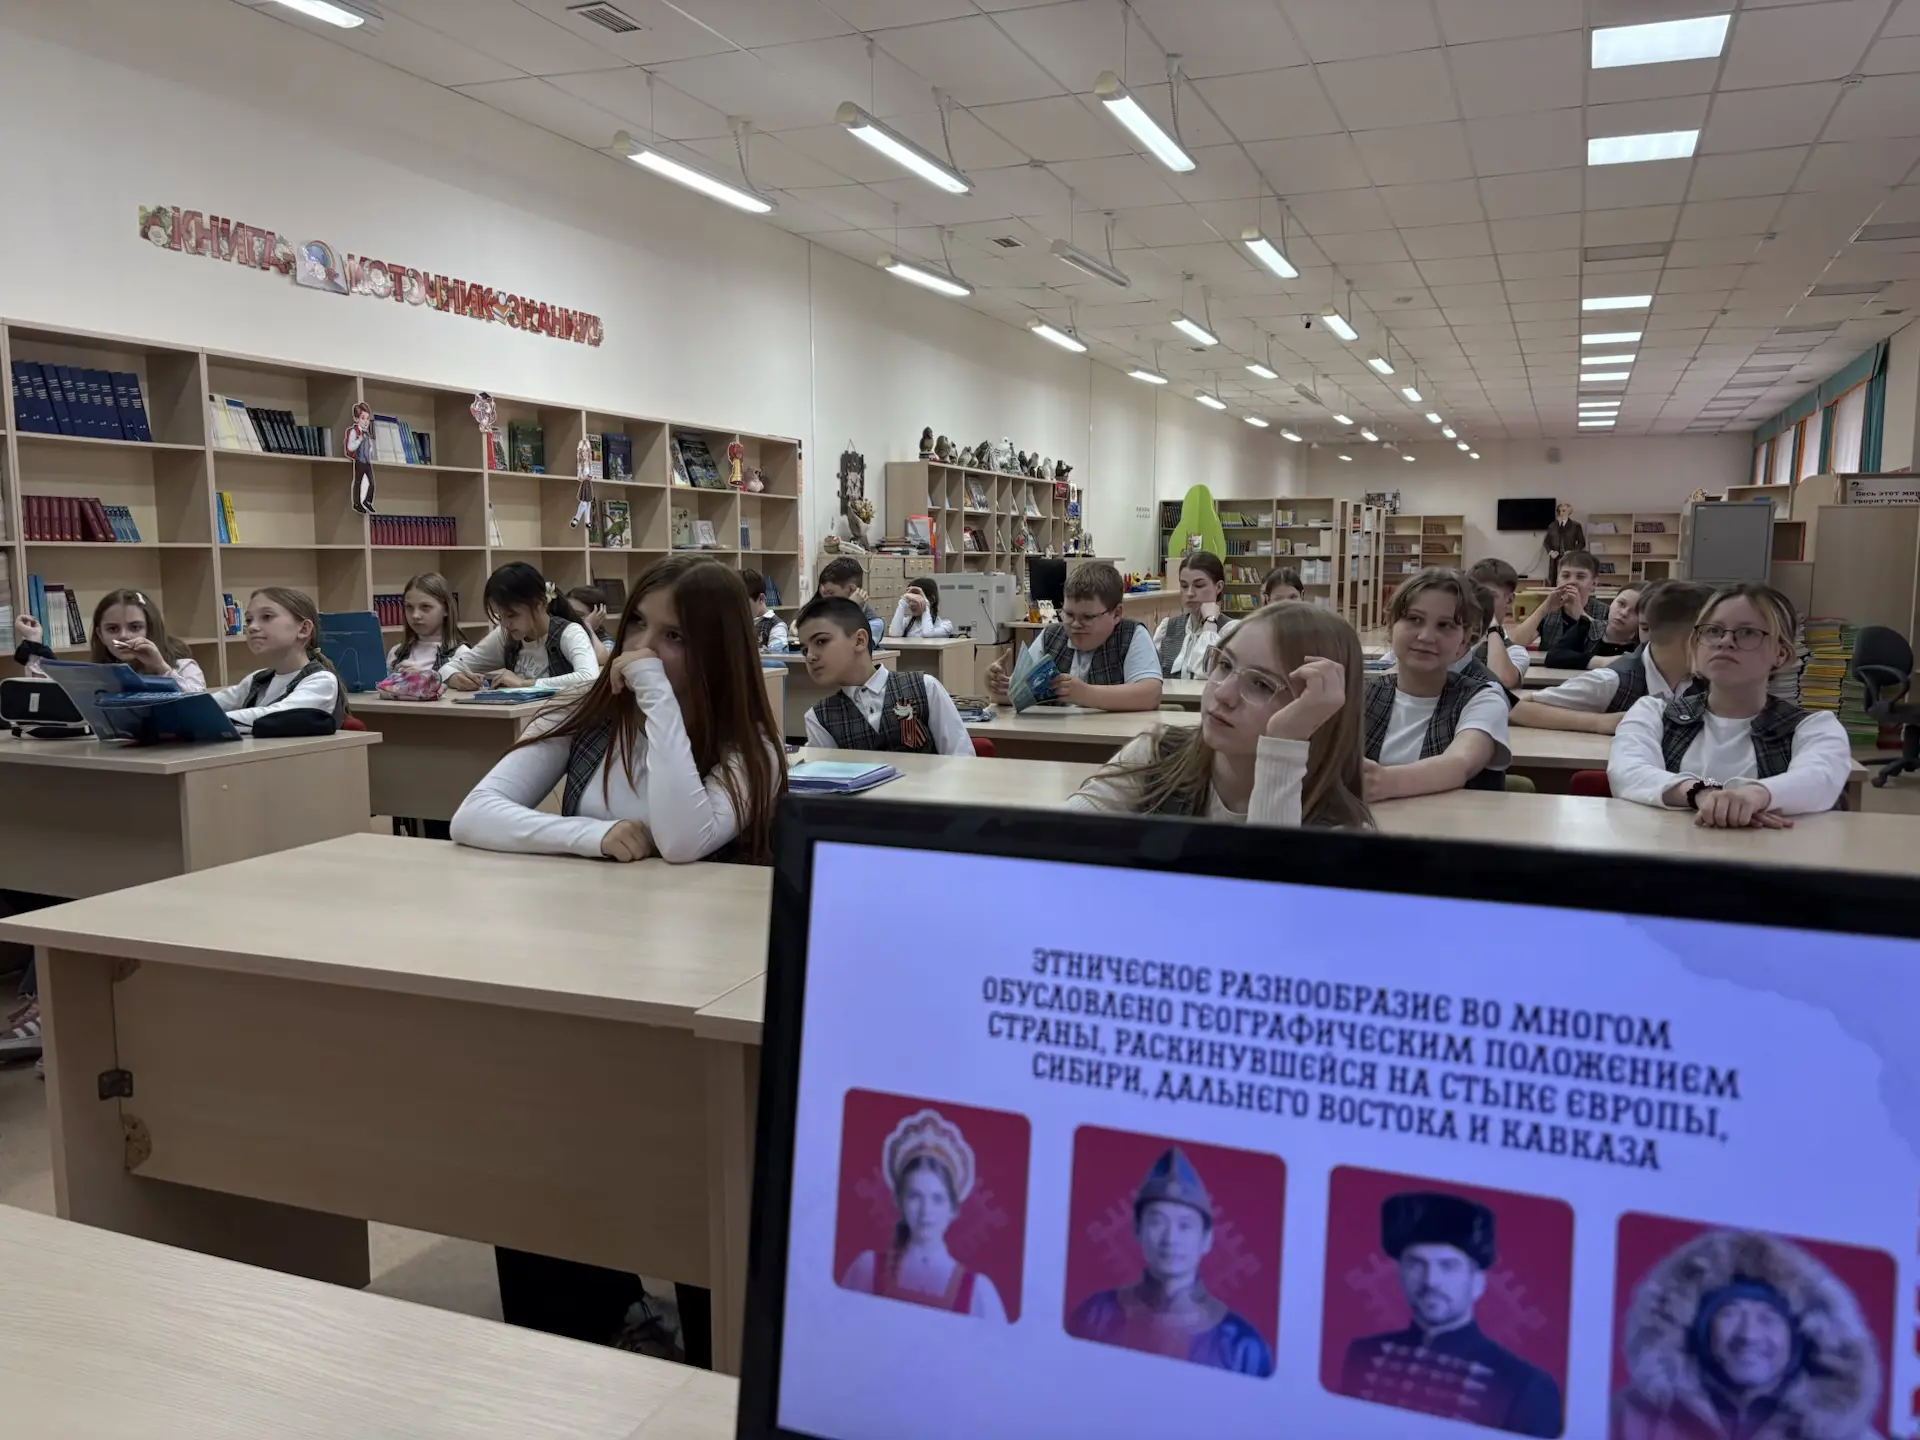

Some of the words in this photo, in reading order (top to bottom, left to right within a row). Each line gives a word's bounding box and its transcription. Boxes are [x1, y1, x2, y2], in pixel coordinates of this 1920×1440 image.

[983, 976, 1173, 1026] ОБУСЛОВЛЕНО
[1180, 1000, 1475, 1066] ГЕОГРАФИЧЕСКИМ
[1485, 1038, 1741, 1100] ПОЛОЖЕНИЕМ
[1032, 948, 1212, 995] ЭТНИЧЕСКОЕ
[1219, 969, 1452, 1023] РАЗНООБРАЗИЕ
[1460, 997, 1501, 1030] ВО
[1509, 1003, 1673, 1051] МНОГОМ
[988, 1011, 1107, 1056] СТРАНЫ,
[1113, 1028, 1378, 1091] РАСКИНУВШЕЙСЯ
[1388, 1064, 1430, 1098] НА
[1440, 1072, 1559, 1115] СТЫКЕ
[1032, 1051, 1149, 1099] СИБИРИ,
[1154, 1070, 1310, 1118] ДАЛЬНЕГО
[1317, 1092, 1458, 1141] ВОСТОКА
[1468, 1113, 1491, 1145] И
[1501, 1118, 1661, 1171] КАВКАЗА
